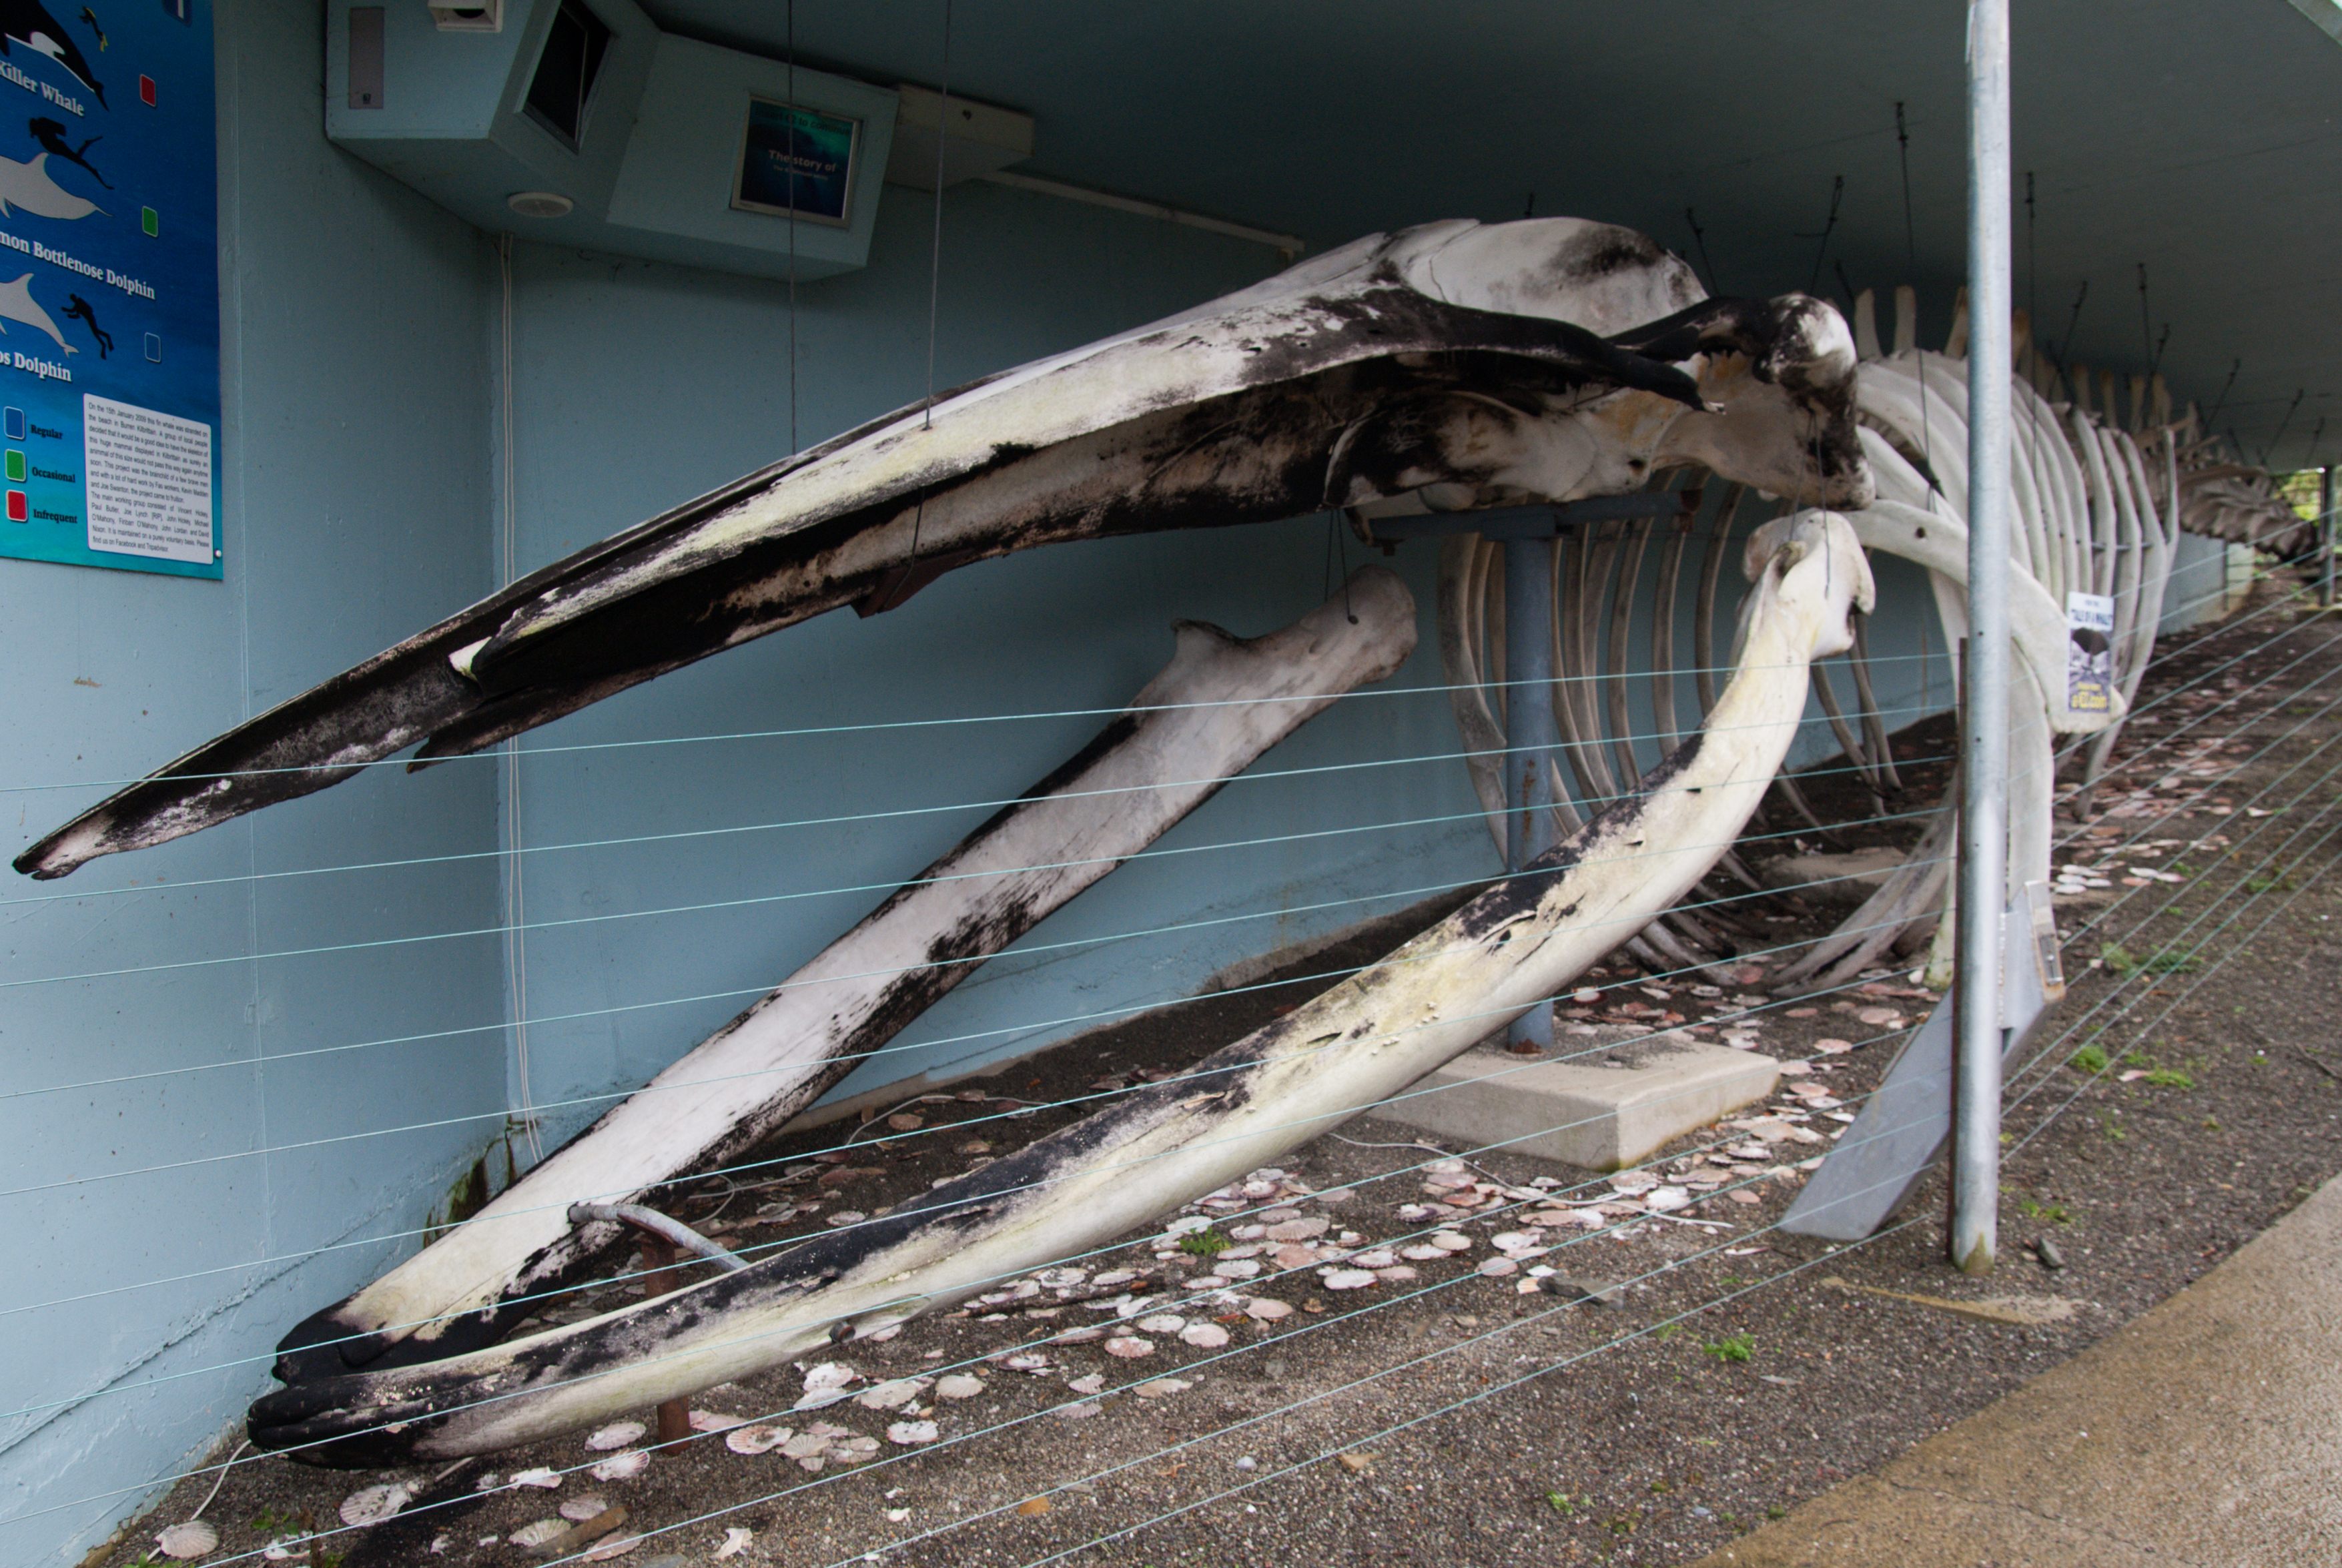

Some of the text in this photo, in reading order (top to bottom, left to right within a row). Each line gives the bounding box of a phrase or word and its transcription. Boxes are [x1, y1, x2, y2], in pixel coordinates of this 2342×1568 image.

[40, 81, 84, 116] Whale
[769, 149, 836, 172] The story of
[33, 241, 103, 280] Bottlenose
[106, 269, 155, 300] Dolphin
[14, 352, 71, 382] Dolphin
[31, 424, 63, 440] Regular
[32, 466, 75, 482] Occasional
[33, 508, 77, 523] Infrequent
